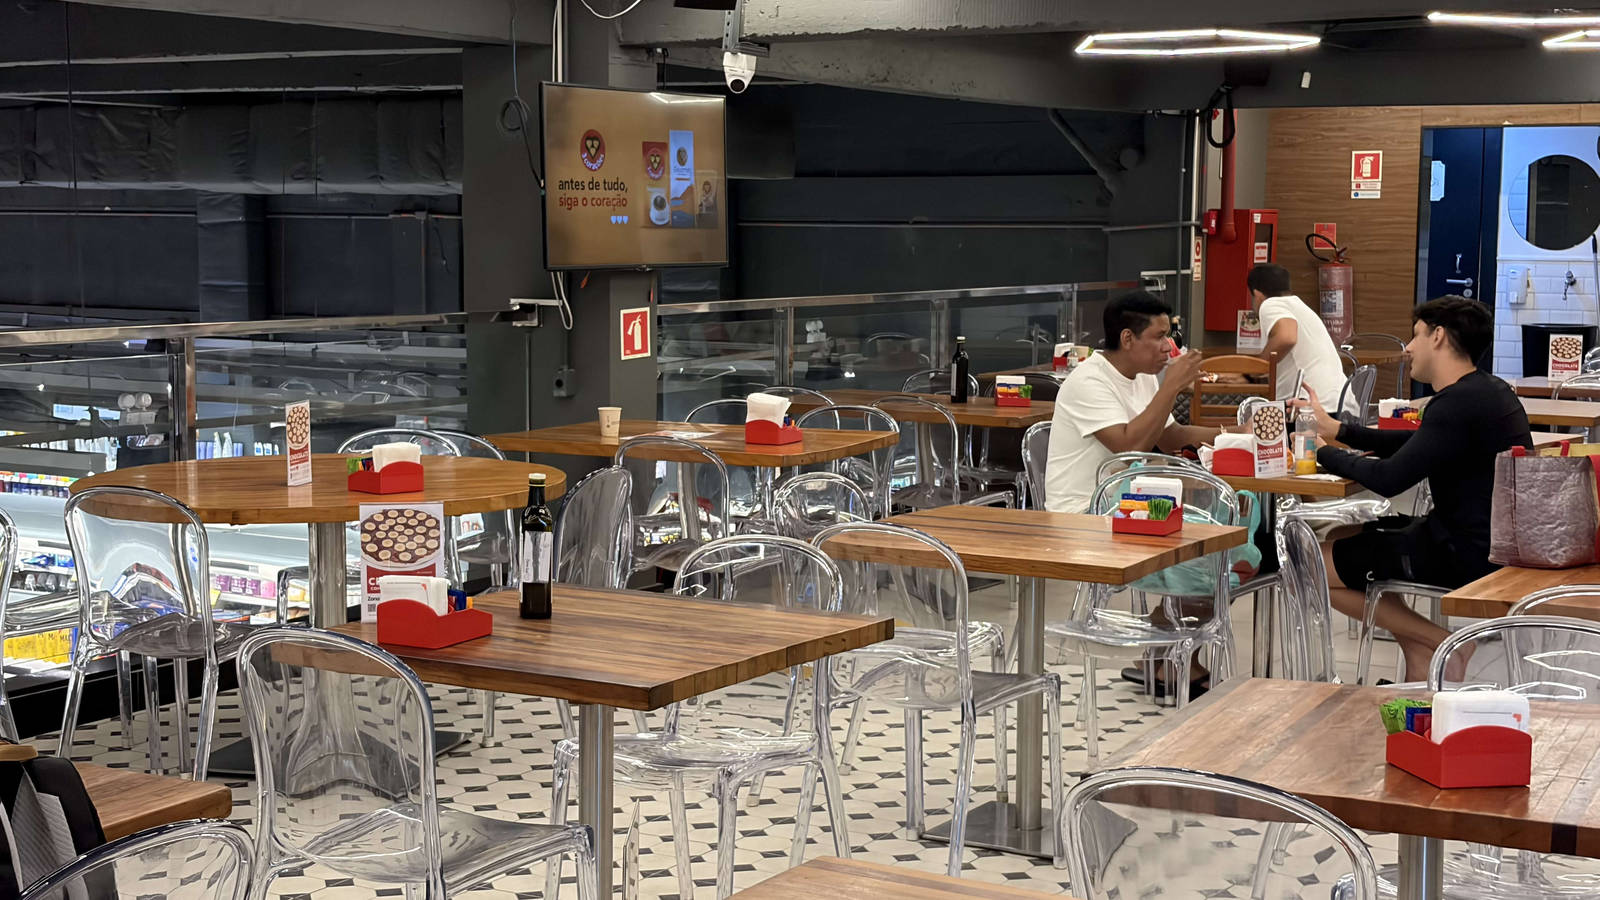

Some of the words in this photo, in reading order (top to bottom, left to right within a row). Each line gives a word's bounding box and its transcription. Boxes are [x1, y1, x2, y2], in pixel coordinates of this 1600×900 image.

[558, 178, 585, 190] antes
[588, 176, 601, 190] de
[603, 176, 628, 193] tudo,
[559, 193, 579, 211] siga
[581, 197, 588, 207] o
[590, 193, 628, 211] coração
